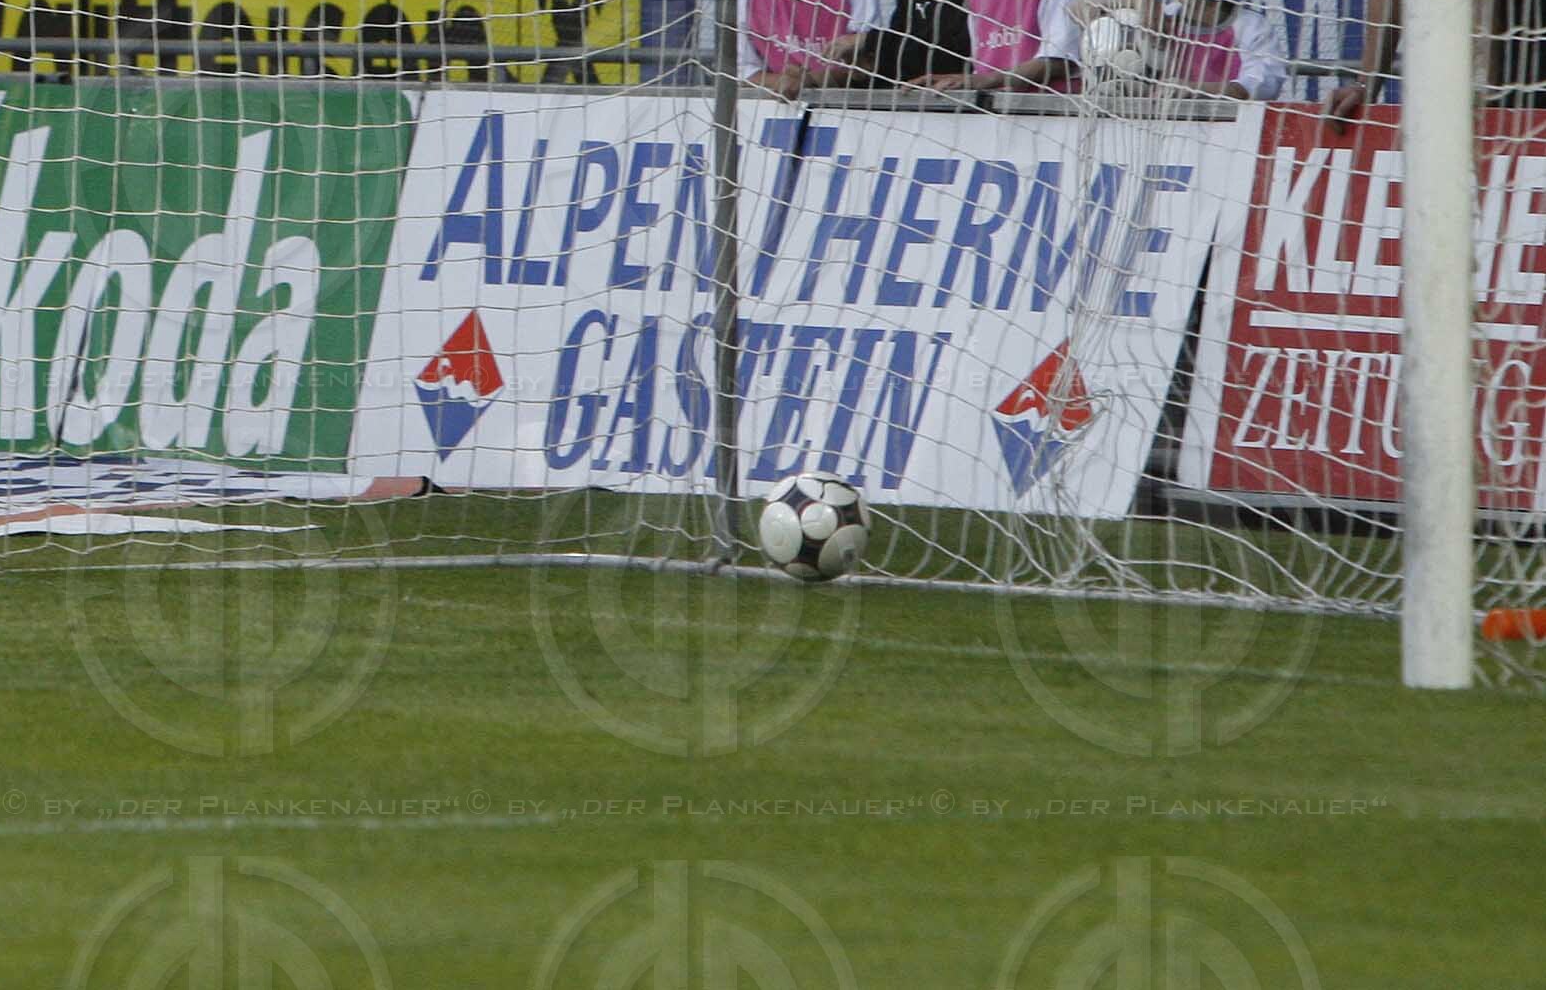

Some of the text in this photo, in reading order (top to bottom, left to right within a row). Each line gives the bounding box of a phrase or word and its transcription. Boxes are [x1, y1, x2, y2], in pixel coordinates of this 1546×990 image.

[1255, 146, 1546, 304] KLEE
[544, 309, 951, 489] GASTEIN
[1233, 344, 1531, 466] ZEITG
